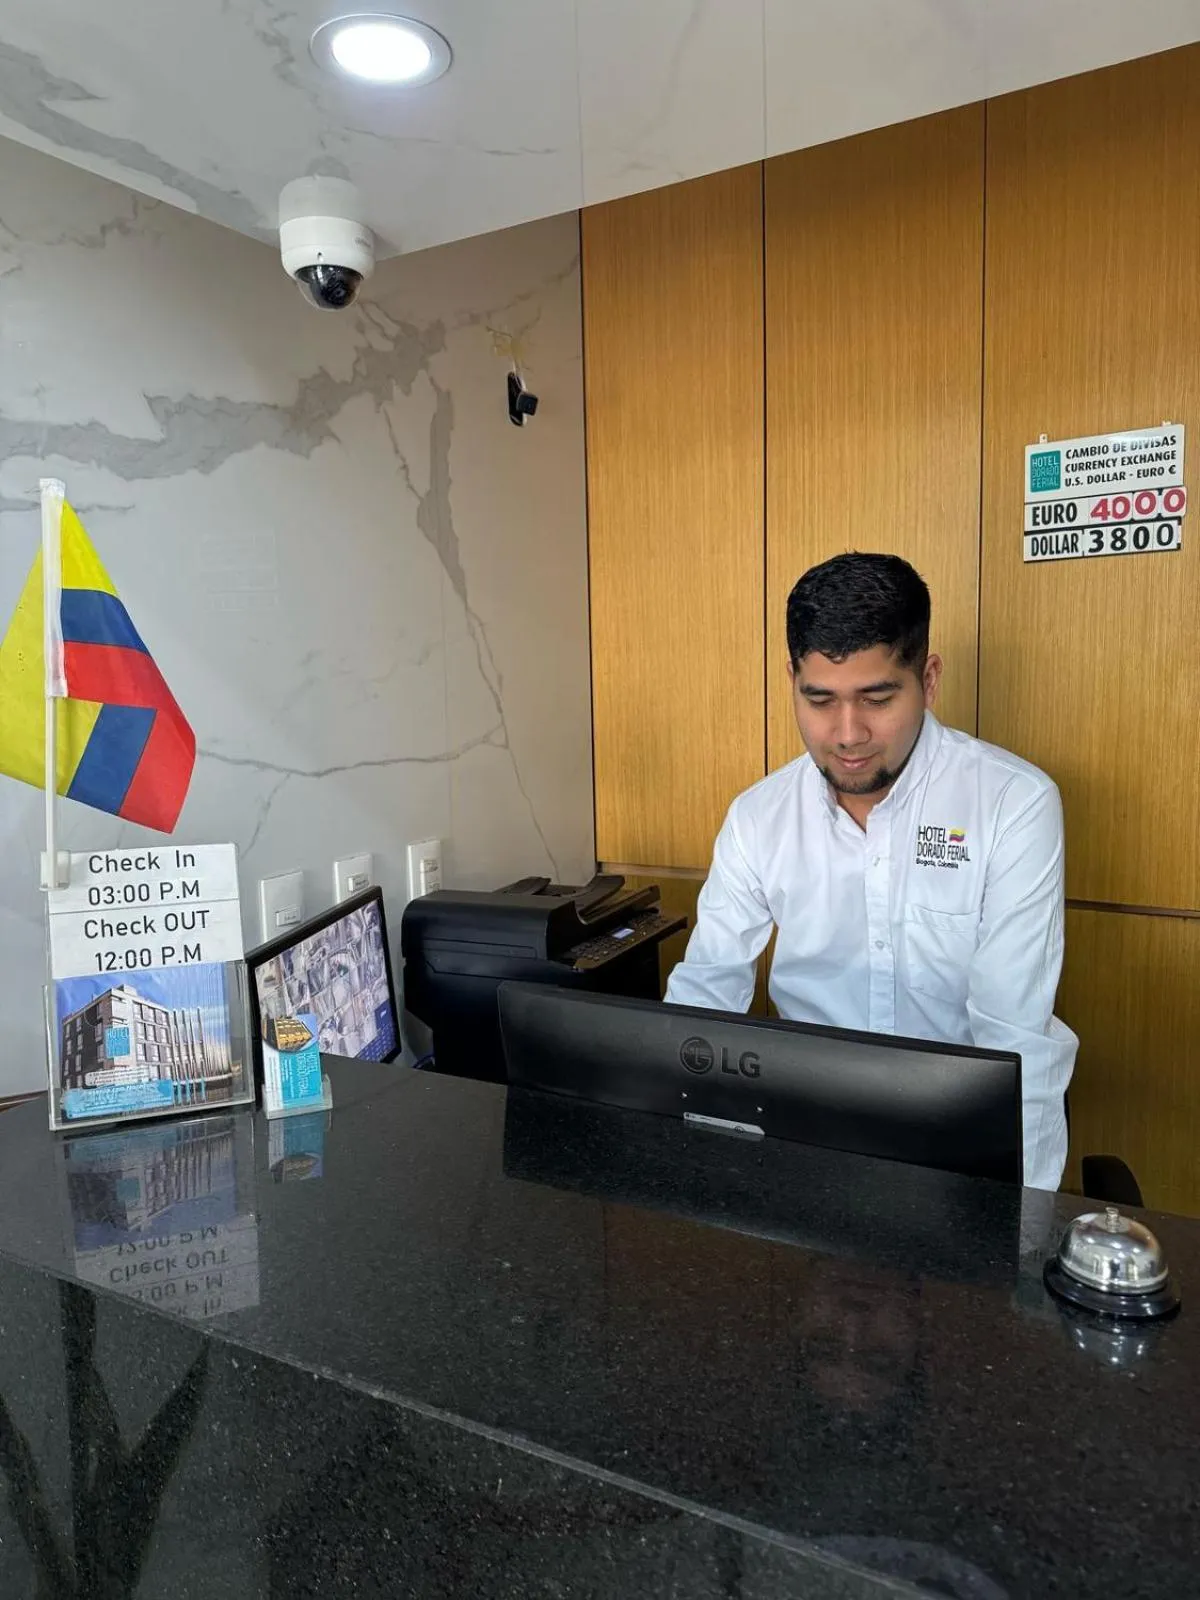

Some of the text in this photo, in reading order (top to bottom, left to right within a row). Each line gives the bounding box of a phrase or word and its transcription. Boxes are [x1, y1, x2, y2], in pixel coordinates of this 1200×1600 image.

[1065, 435, 1177, 460] CAMBIO DE DIVISAS
[1031, 455, 1060, 468] HOTEL
[1065, 450, 1177, 474] CURRENCY EXCHANGE
[1031, 476, 1060, 490] FERIAL
[1064, 476, 1084, 488] U.S.
[1086, 471, 1126, 485] DOLLAR
[1136, 466, 1165, 480] EURO
[1168, 464, 1176, 475] €
[1031, 488, 1186, 527] EURO 4000
[1030, 523, 1175, 557] DOLLAR 3800
[917, 826, 947, 844] HOTEL
[88, 849, 196, 874] Check In
[916, 841, 971, 862] DORADO FERIAL
[88, 879, 200, 906] 03:00 P.M
[84, 909, 210, 939] Check OUT
[94, 943, 202, 972] 12:00 P.M
[720, 1046, 762, 1079] LG
